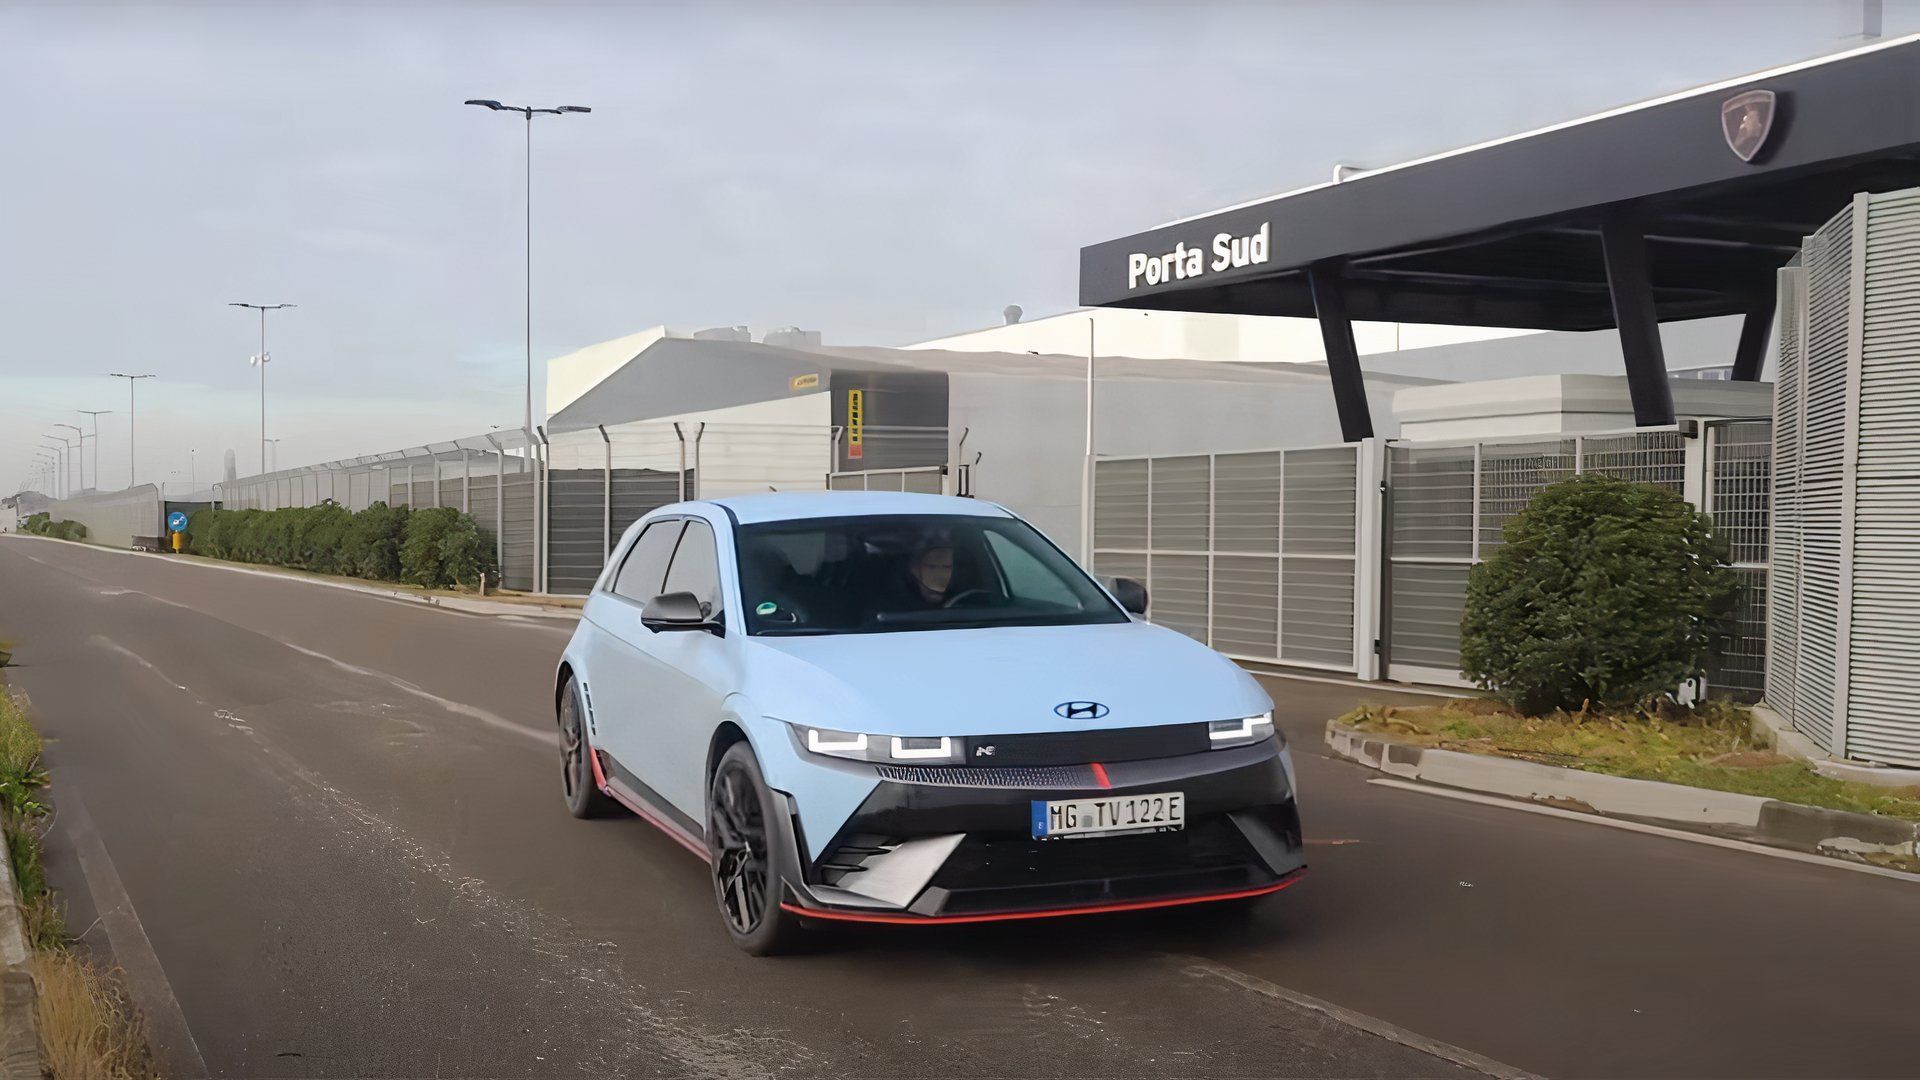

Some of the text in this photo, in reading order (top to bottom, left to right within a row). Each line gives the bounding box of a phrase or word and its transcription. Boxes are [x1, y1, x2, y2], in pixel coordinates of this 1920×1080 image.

[1129, 222, 1270, 289] Porta Sud
[1050, 805, 1077, 830] MG
